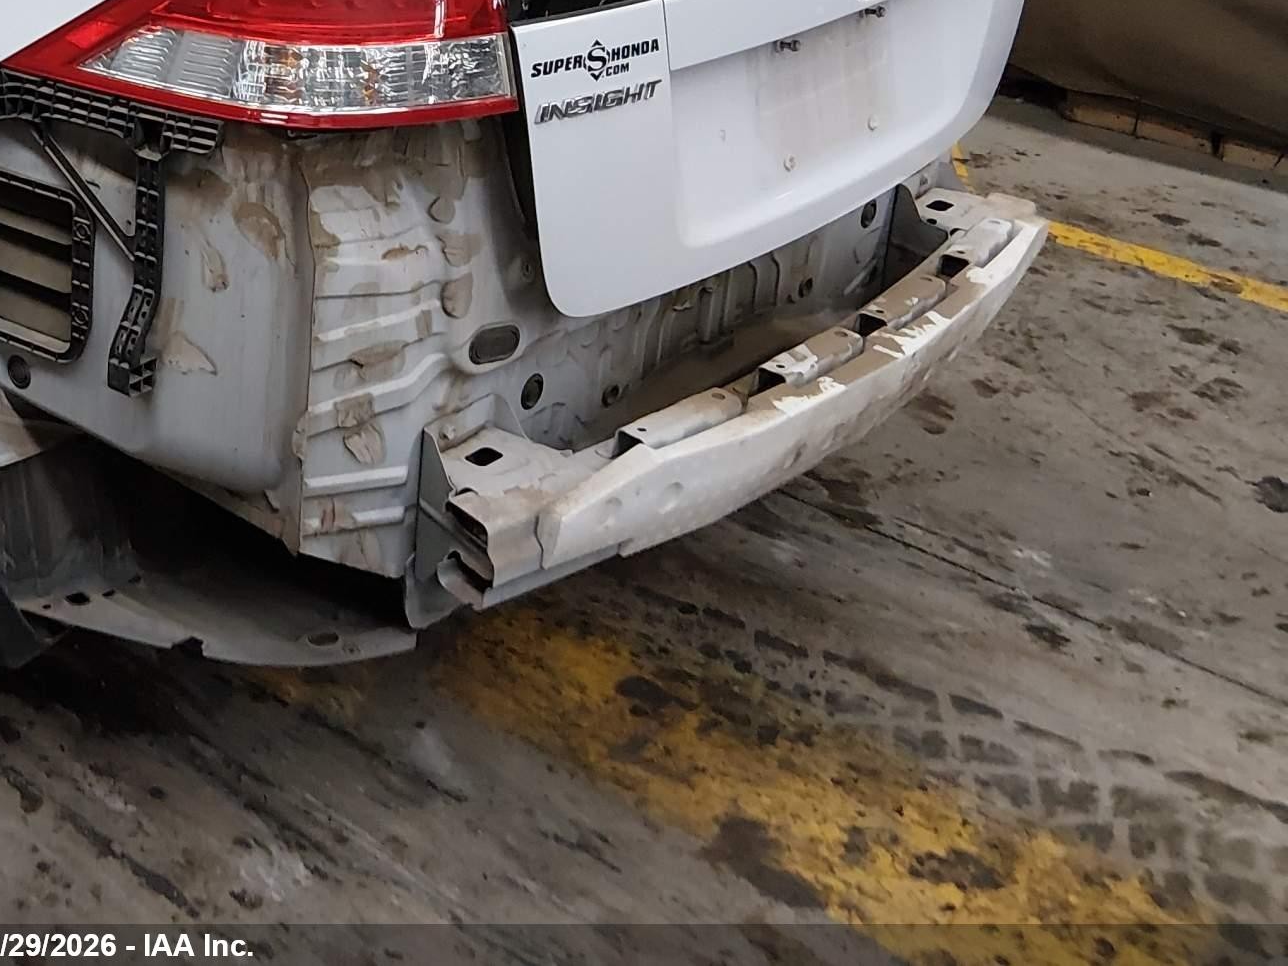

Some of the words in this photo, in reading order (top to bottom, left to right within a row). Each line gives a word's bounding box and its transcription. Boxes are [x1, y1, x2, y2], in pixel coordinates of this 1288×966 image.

[530, 54, 584, 79] SUPER
[610, 38, 660, 62] HONDA
[534, 79, 662, 125] INSIGHT
